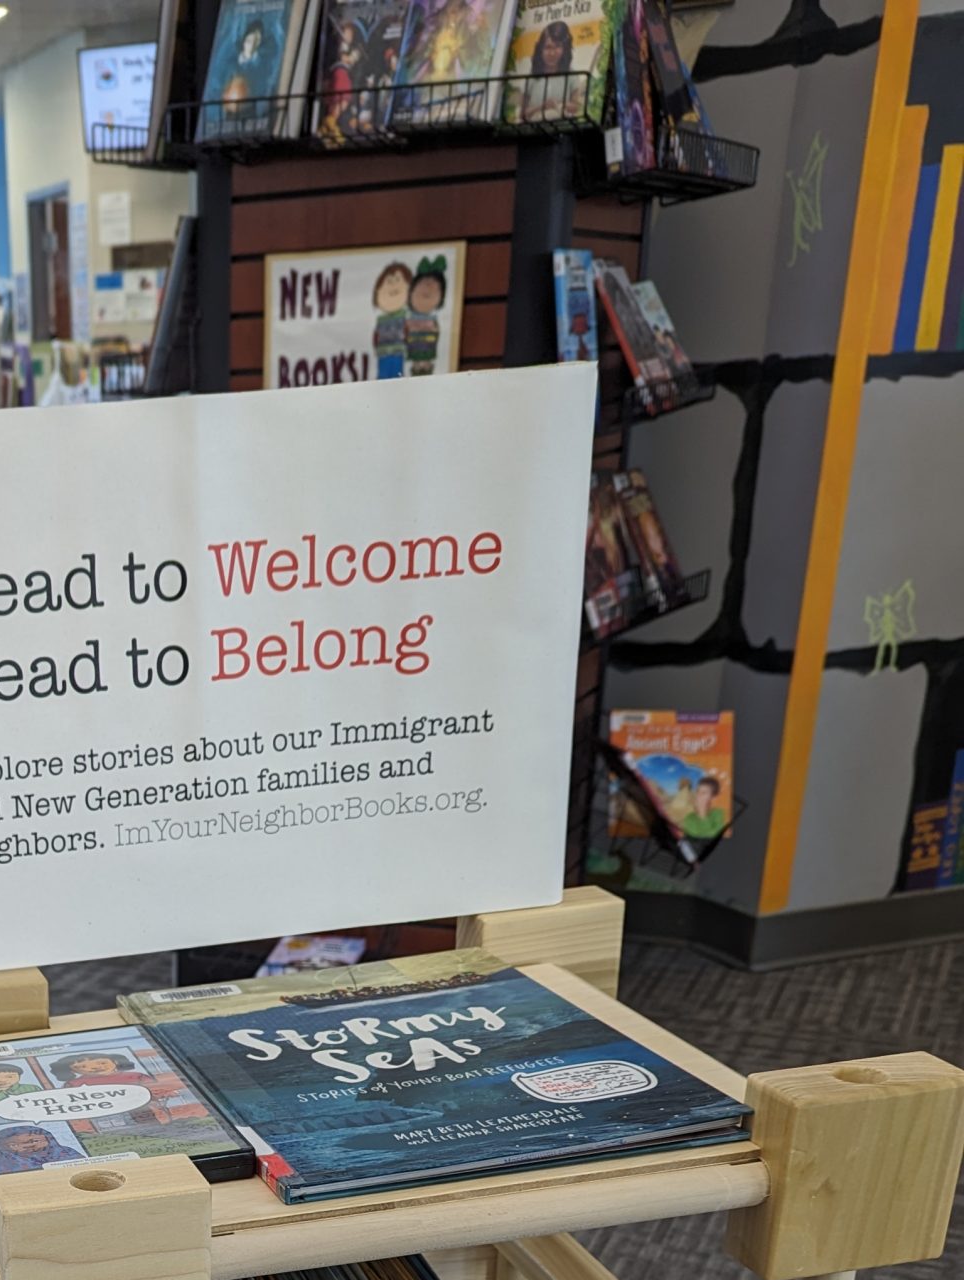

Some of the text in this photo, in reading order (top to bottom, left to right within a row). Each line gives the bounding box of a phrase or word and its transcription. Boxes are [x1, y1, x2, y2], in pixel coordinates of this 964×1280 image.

[279, 268, 340, 320] NEW
[122, 551, 189, 606] to
[208, 530, 503, 597] Welcome
[126, 637, 190, 689] to
[210, 615, 434, 681] Belong
[72, 739, 174, 777] stories
[182, 730, 265, 765] about
[271, 727, 323, 754] our
[329, 709, 495, 749] Immigrant
[10, 791, 77, 820] New
[84, 772, 250, 813] Generation
[256, 760, 371, 795] families
[378, 751, 435, 781] and
[113, 783, 489, 849] ImYourNeighborBooks.org.
[14, 1087, 127, 1109] I'm New
[370, 1081, 386, 1094] of
[388, 1075, 442, 1091] YOUNG
[447, 1069, 482, 1082] BOAT
[483, 1055, 565, 1076] REFUGEES
[45, 1100, 113, 1116] Here
[393, 1105, 582, 1142] MARY BETH LEATHERDALE
[430, 1129, 491, 1143] ELEANOR
[495, 1112, 586, 1133] SHAKESPEARE
